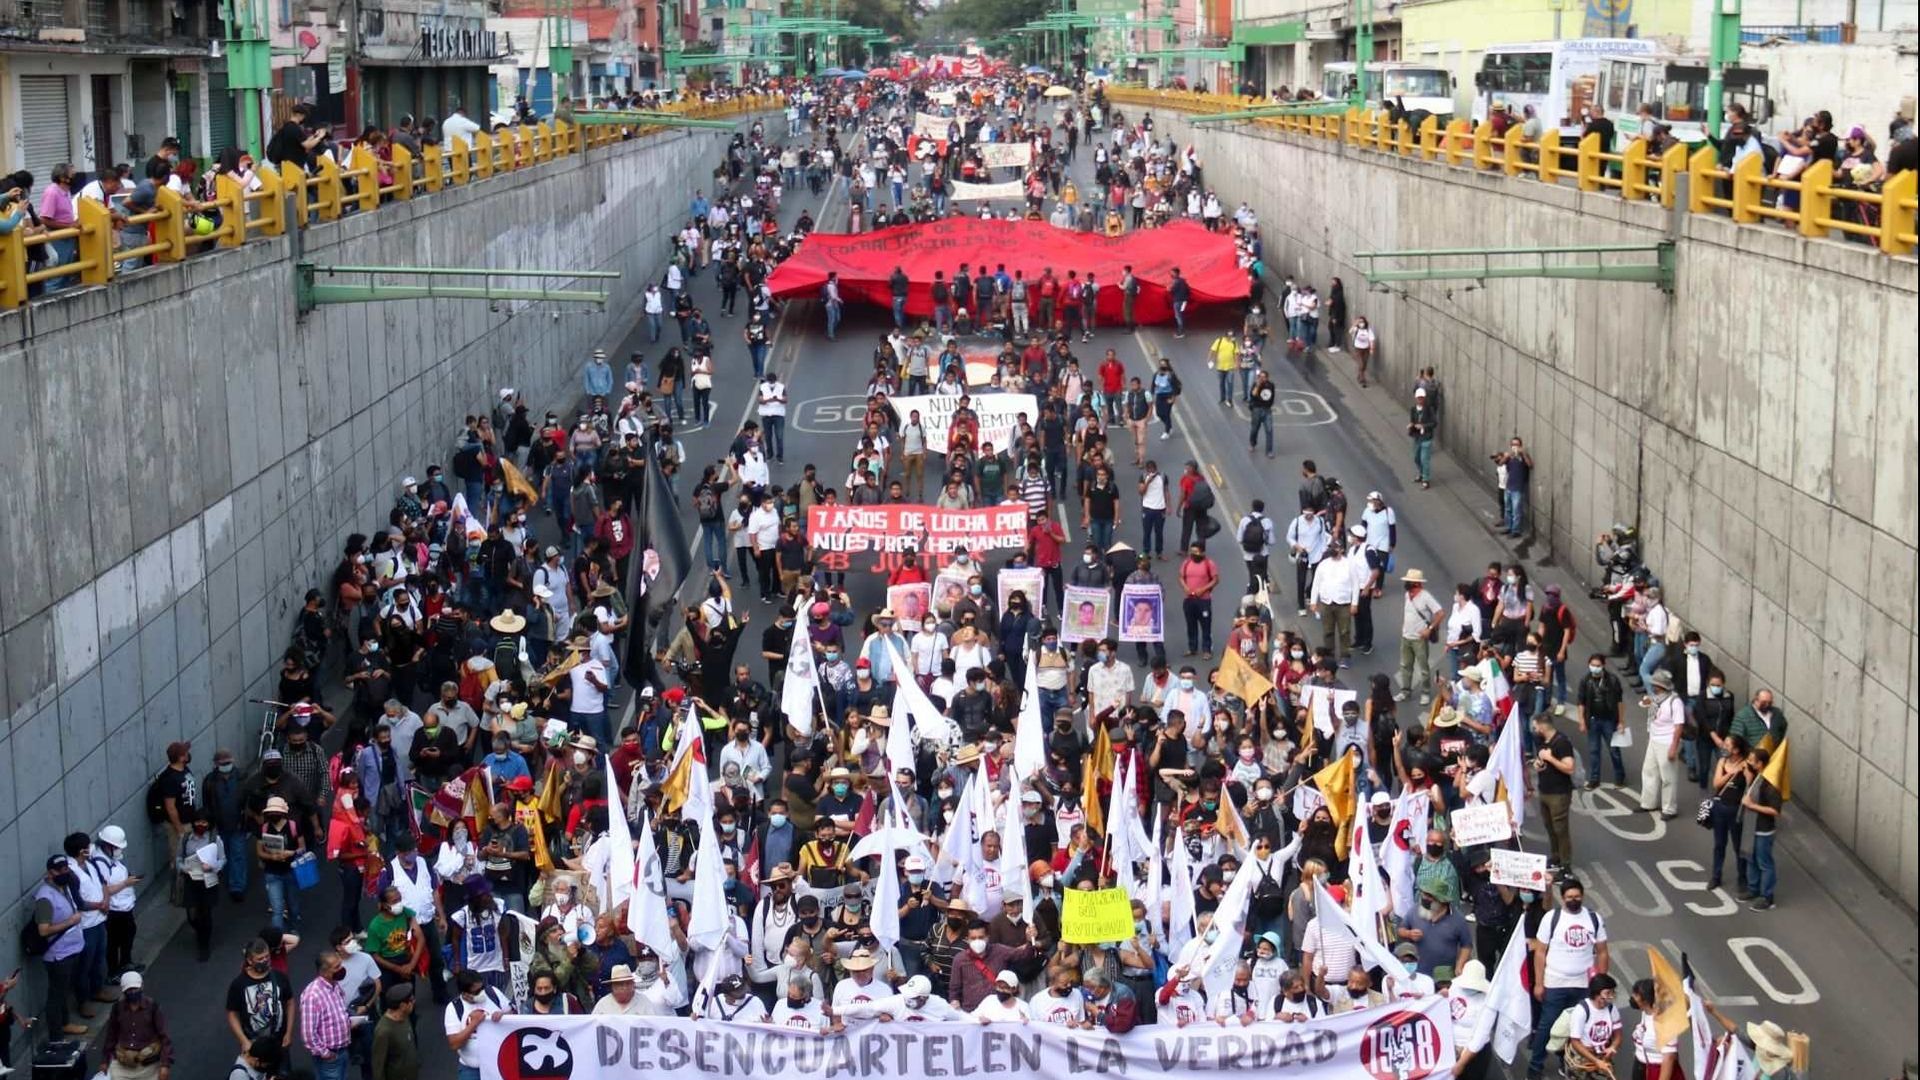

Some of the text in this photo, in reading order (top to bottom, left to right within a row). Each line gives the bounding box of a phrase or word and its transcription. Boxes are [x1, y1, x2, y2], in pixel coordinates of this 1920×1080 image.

[928, 397, 985, 413] NUNA
[816, 507, 1027, 532] 7 AÑOS DE LUCHA POR
[813, 532, 1025, 554] NUESTROS HERMANOS
[818, 552, 850, 570] 43
[596, 1023, 1339, 1079] DESENCUARTELEN LA VERDAD
[1367, 1019, 1435, 1075] 1968
